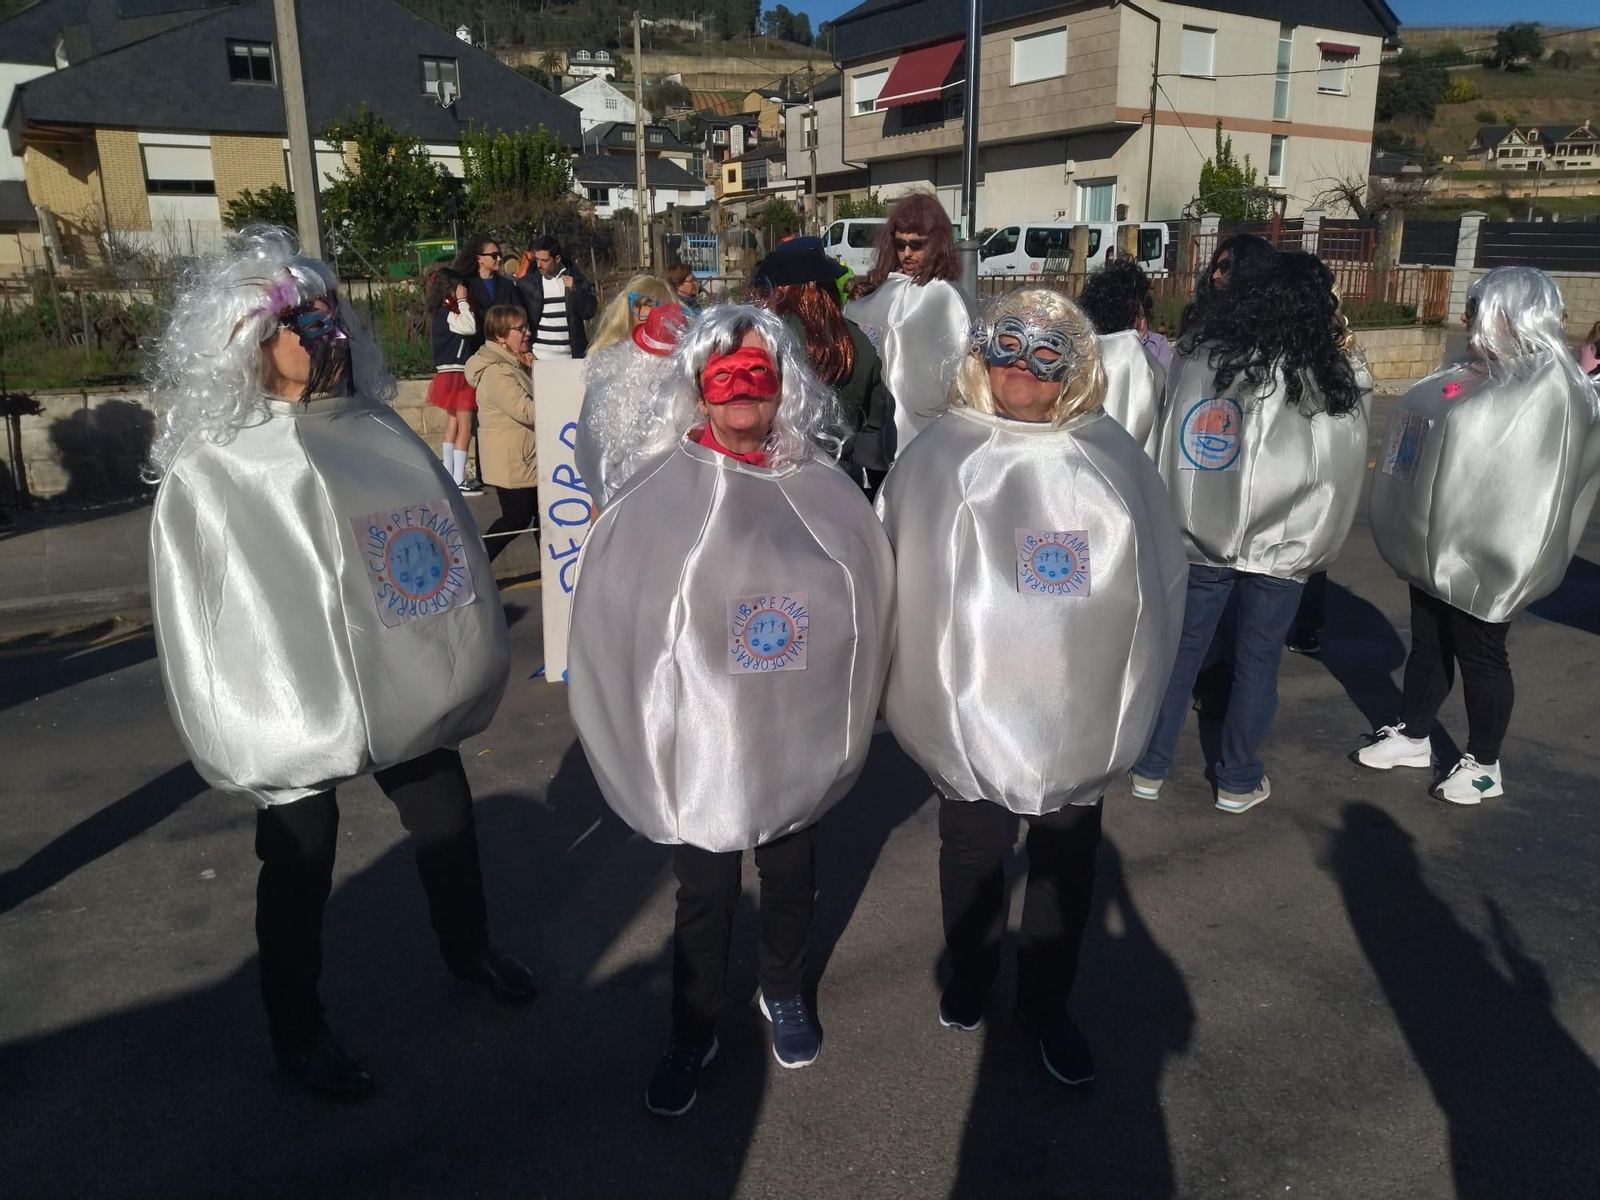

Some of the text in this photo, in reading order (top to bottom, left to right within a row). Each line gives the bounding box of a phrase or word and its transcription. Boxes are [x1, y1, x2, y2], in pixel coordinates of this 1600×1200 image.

[368, 508, 465, 616] CLUB PETANCA VALDEORRAS
[1020, 533, 1090, 594] CLUB PETANCA VALDEORRAS
[731, 596, 809, 671] CLUB PETANCA VALDEORRAS
